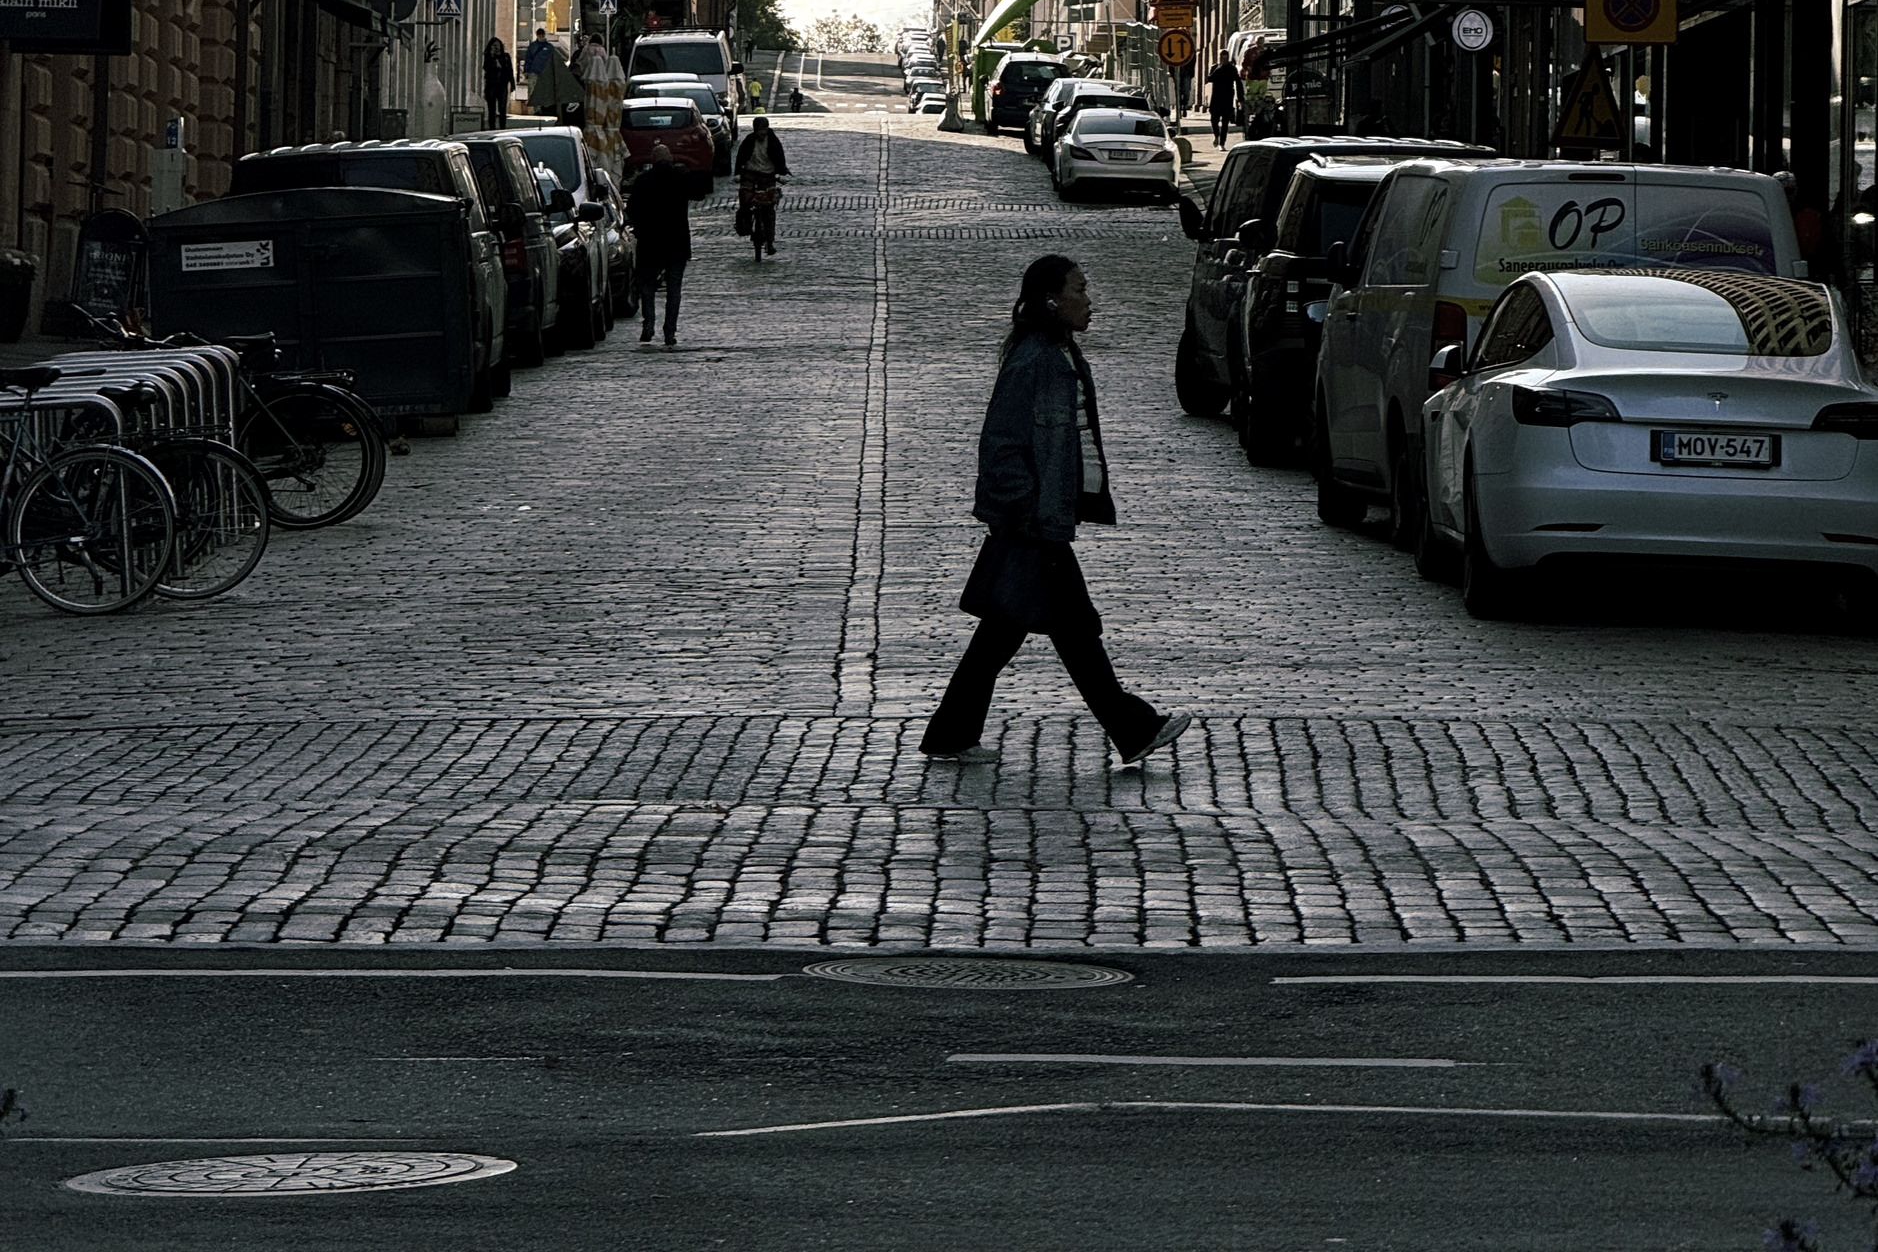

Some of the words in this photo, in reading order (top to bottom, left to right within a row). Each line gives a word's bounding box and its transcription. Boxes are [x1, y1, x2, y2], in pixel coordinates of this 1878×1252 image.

[1462, 27, 1484, 35] EMO
[1057, 35, 1073, 52] P
[1548, 196, 1626, 251] OP
[1678, 436, 1765, 458] MOV-547
